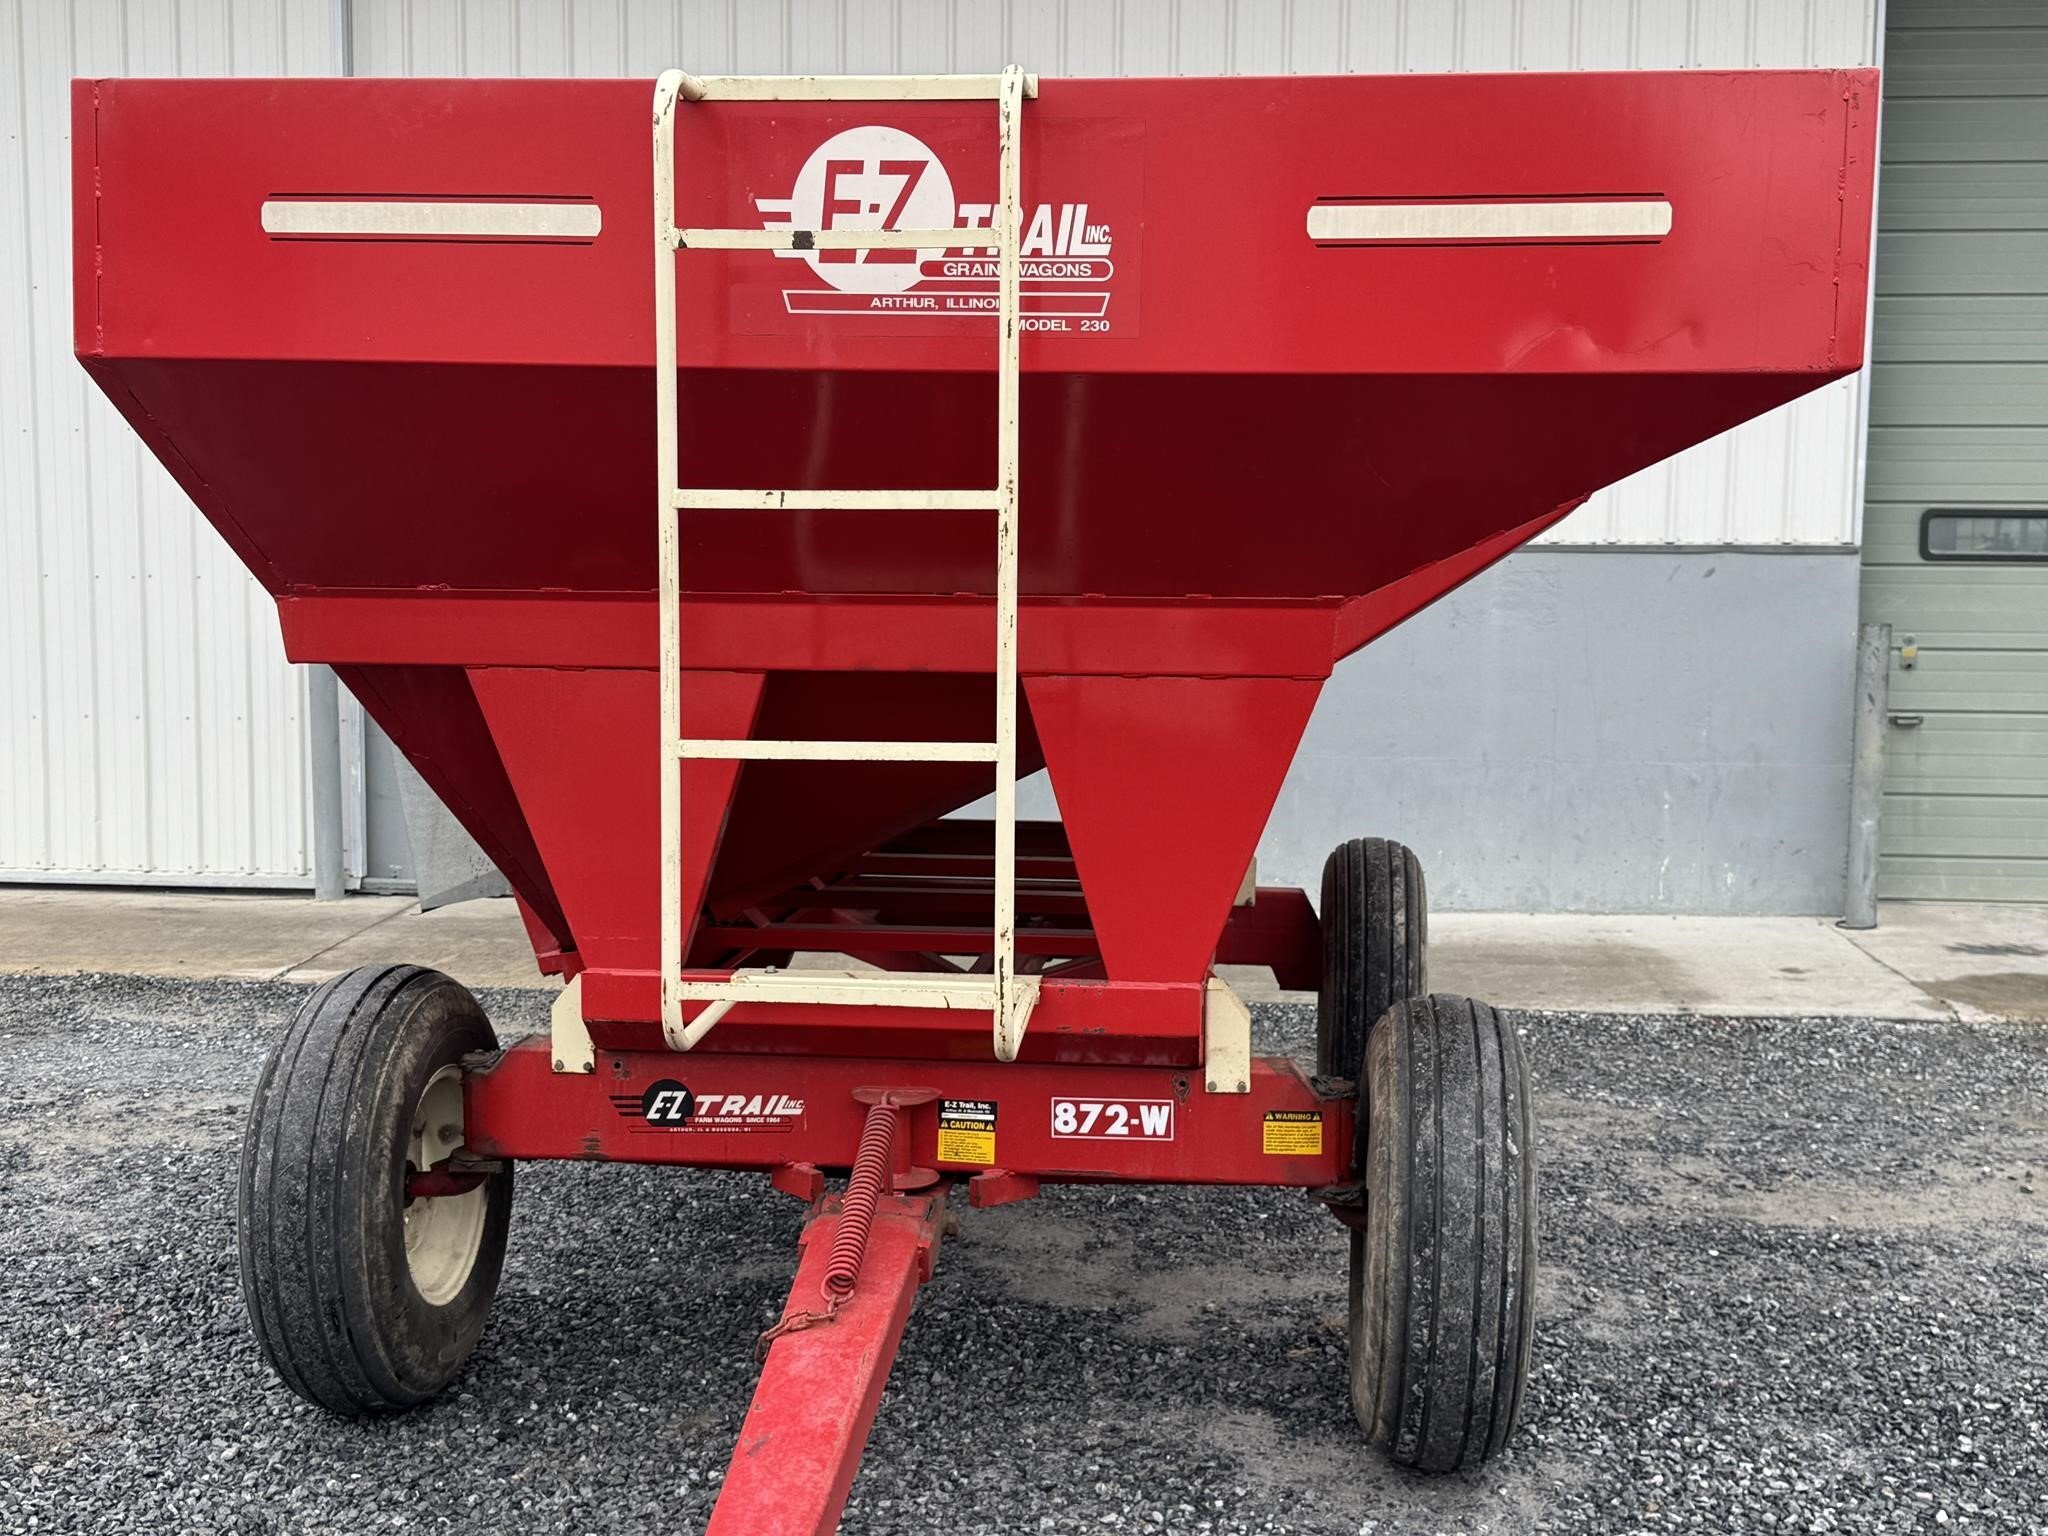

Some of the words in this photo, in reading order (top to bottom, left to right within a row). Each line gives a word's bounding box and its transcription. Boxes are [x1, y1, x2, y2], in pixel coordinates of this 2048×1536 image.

[1085, 225, 1112, 243] INC.
[943, 262, 1000, 277] GRAIN
[870, 297, 939, 310] ARTHUR,
[946, 298, 1000, 309] ILLINOI
[1080, 320, 1110, 332] 230
[646, 1090, 687, 1119] E-Z
[695, 1095, 804, 1115] TRAIL
[784, 1099, 805, 1109] INC.
[944, 1100, 958, 1108] E-Z
[958, 1101, 976, 1109] Trail,
[977, 1102, 992, 1110] Inc.
[1054, 1101, 1170, 1136] 872-W
[1274, 1112, 1312, 1121] WARNING
[950, 1120, 985, 1130] CAUTION
